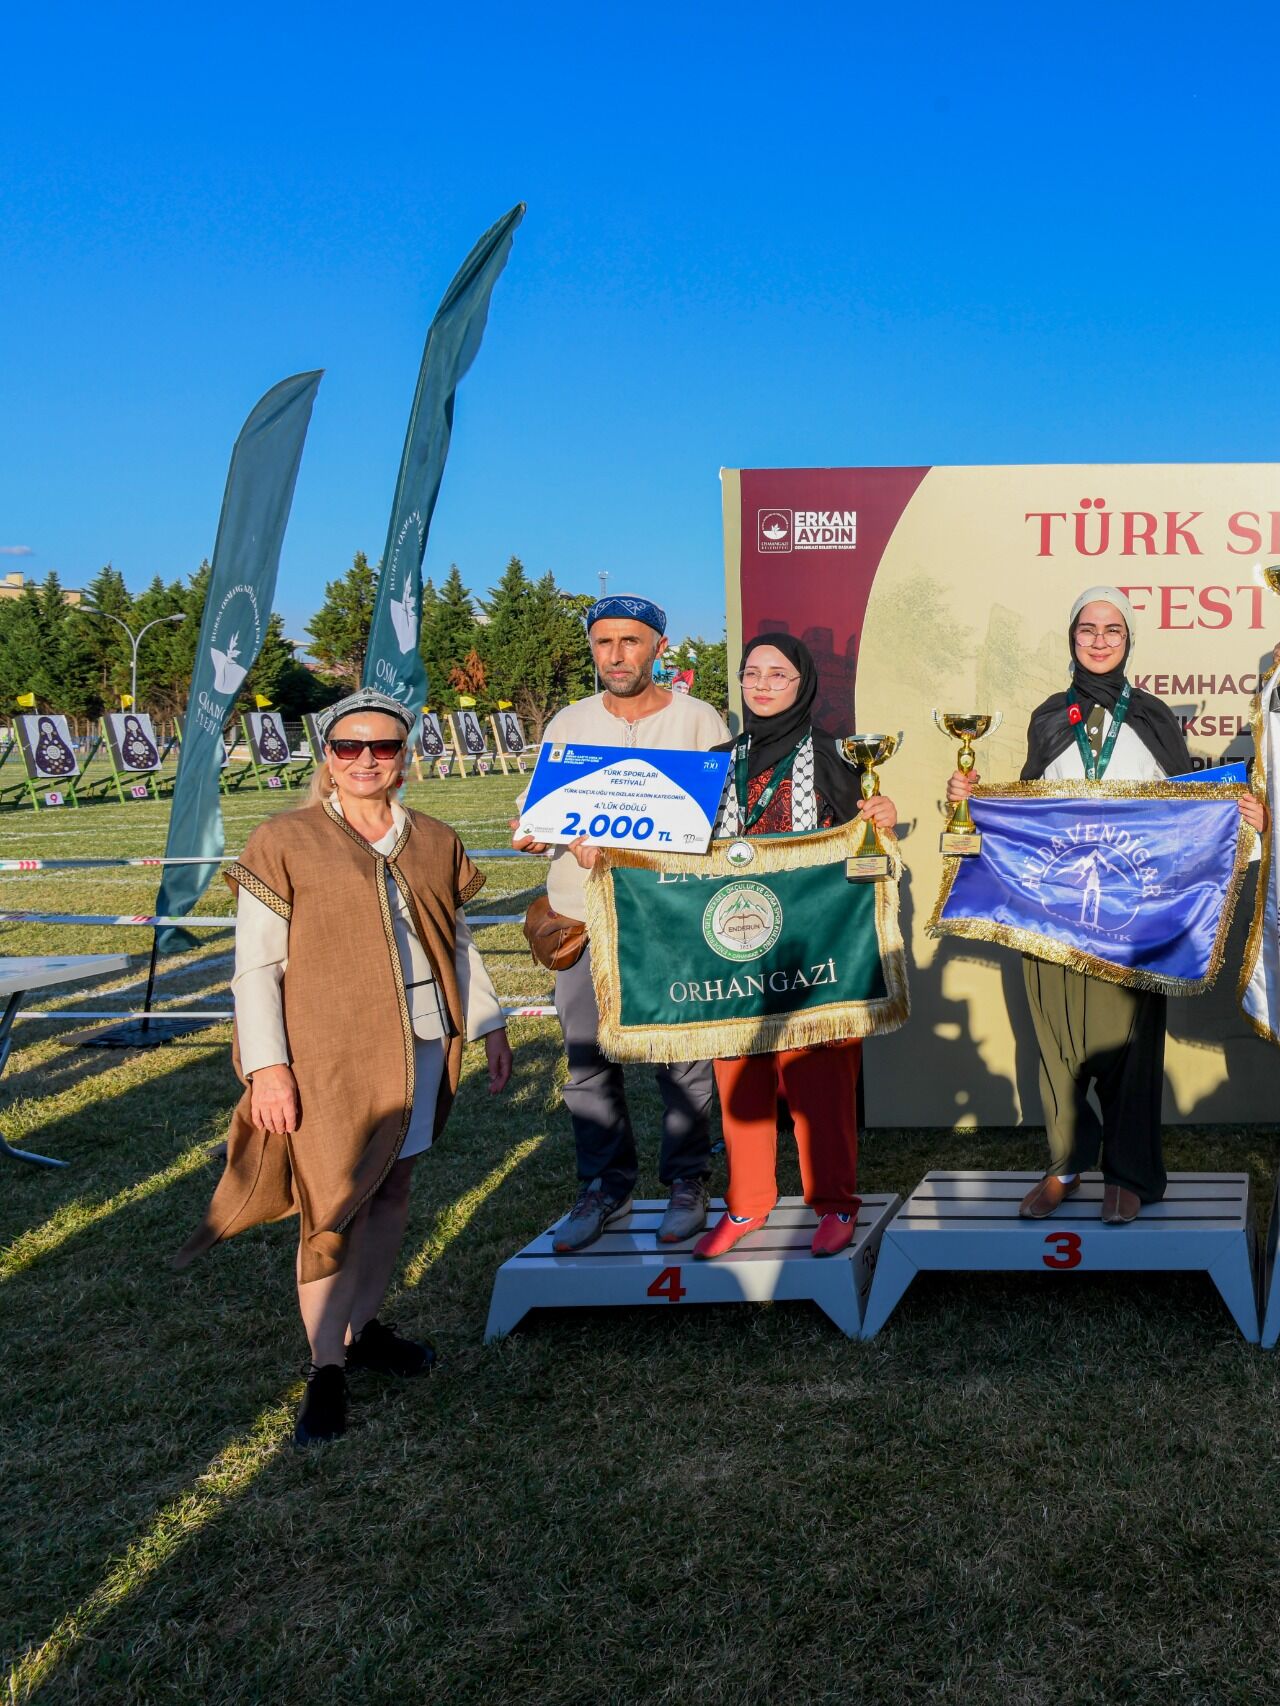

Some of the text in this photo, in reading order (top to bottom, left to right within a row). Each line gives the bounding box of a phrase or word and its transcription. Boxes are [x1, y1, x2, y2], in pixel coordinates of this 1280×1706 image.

[795, 511, 856, 526] ERKAN
[1024, 497, 1205, 556] TÜRK
[797, 528, 853, 542] AYDIN
[603, 768, 622, 777] TÜRK
[269, 777, 280, 787] 12
[610, 777, 646, 786] FESTİVALİ
[132, 786, 146, 797] 10
[49, 793, 58, 804] 9
[619, 803, 647, 812] ÖDÜLÜ
[560, 812, 673, 842] 2.000 TL
[726, 883, 755, 894] OKÇULUK
[756, 884, 764, 893] VE
[728, 924, 760, 933] ENDERUN
[669, 957, 838, 1004] ORHANGAZİ
[1042, 1232, 1082, 1269] 3
[647, 1266, 686, 1302] 4
